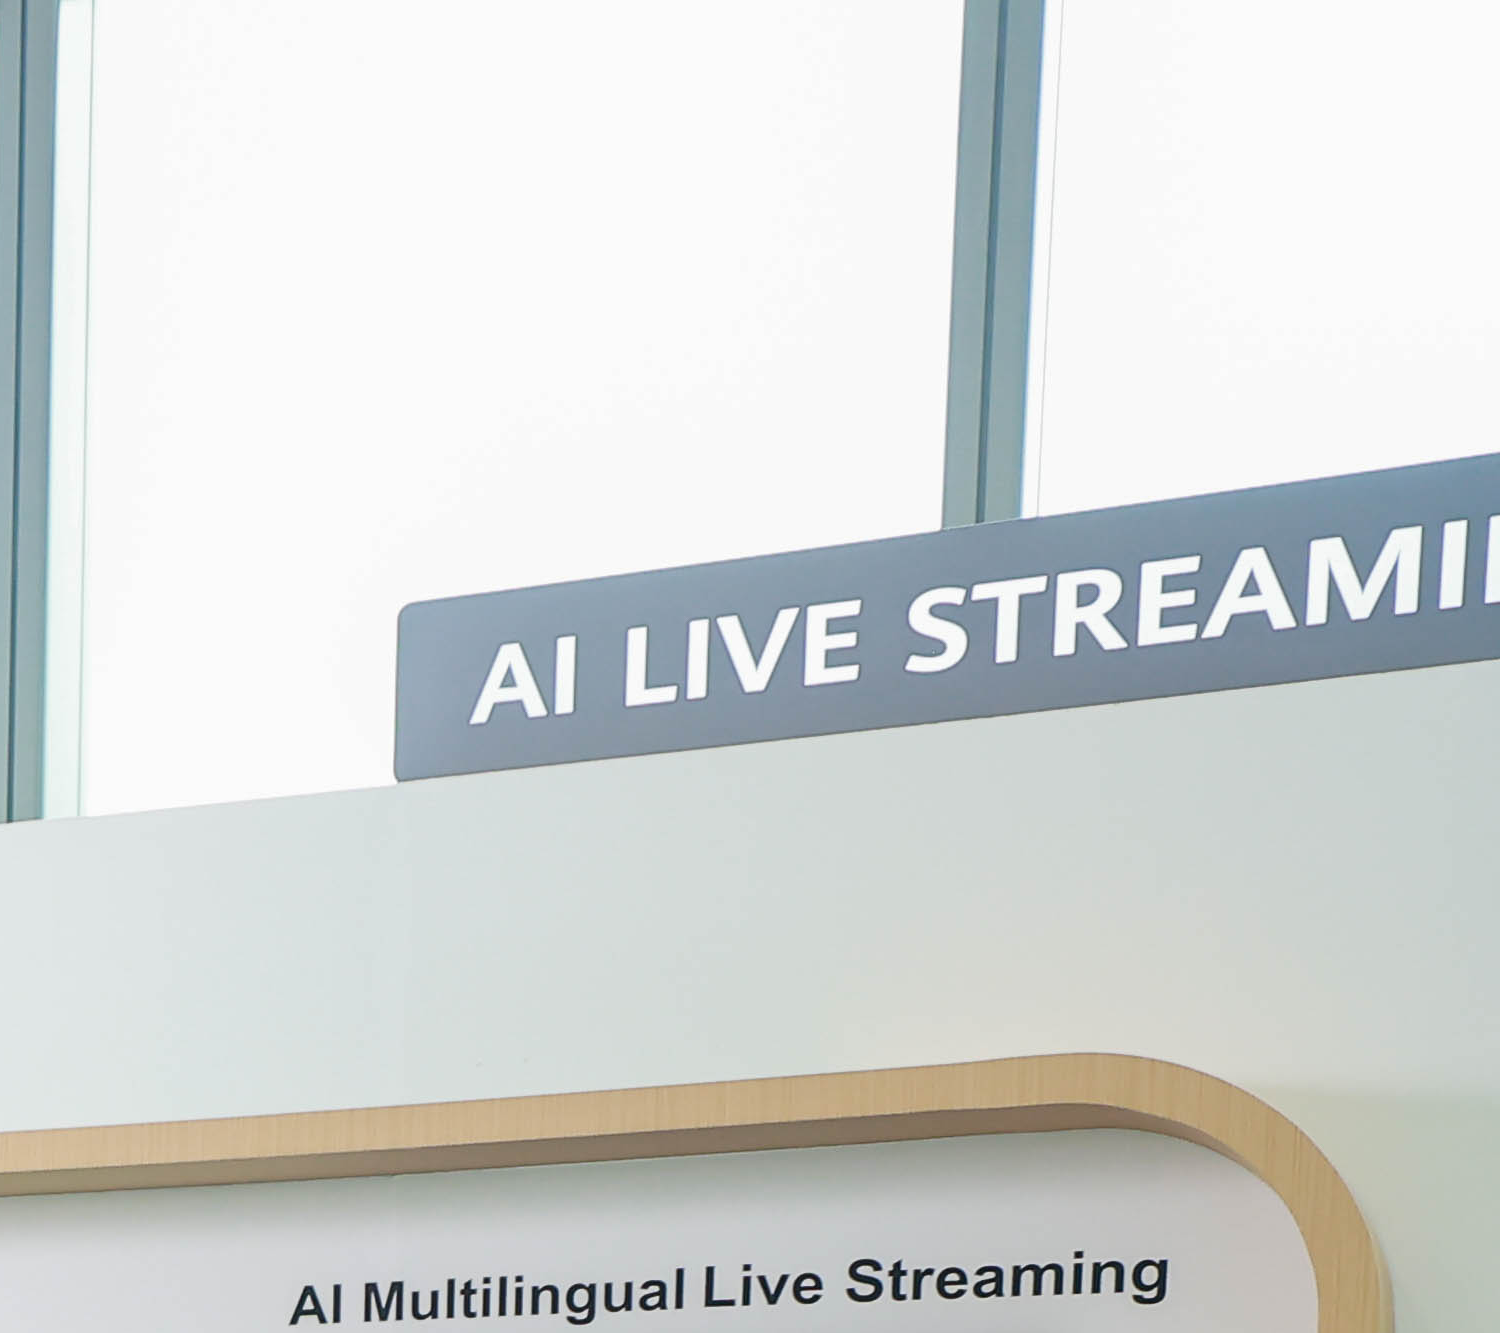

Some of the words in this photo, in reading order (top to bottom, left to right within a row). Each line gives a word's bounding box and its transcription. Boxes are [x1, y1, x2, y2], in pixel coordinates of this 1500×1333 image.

[469, 636, 577, 725] AI
[624, 599, 862, 707] LIVE
[289, 1283, 342, 1326] AI
[363, 1267, 685, 1326] Multilingual
[704, 1263, 824, 1308] Live
[846, 1250, 1168, 1305] Streaming
